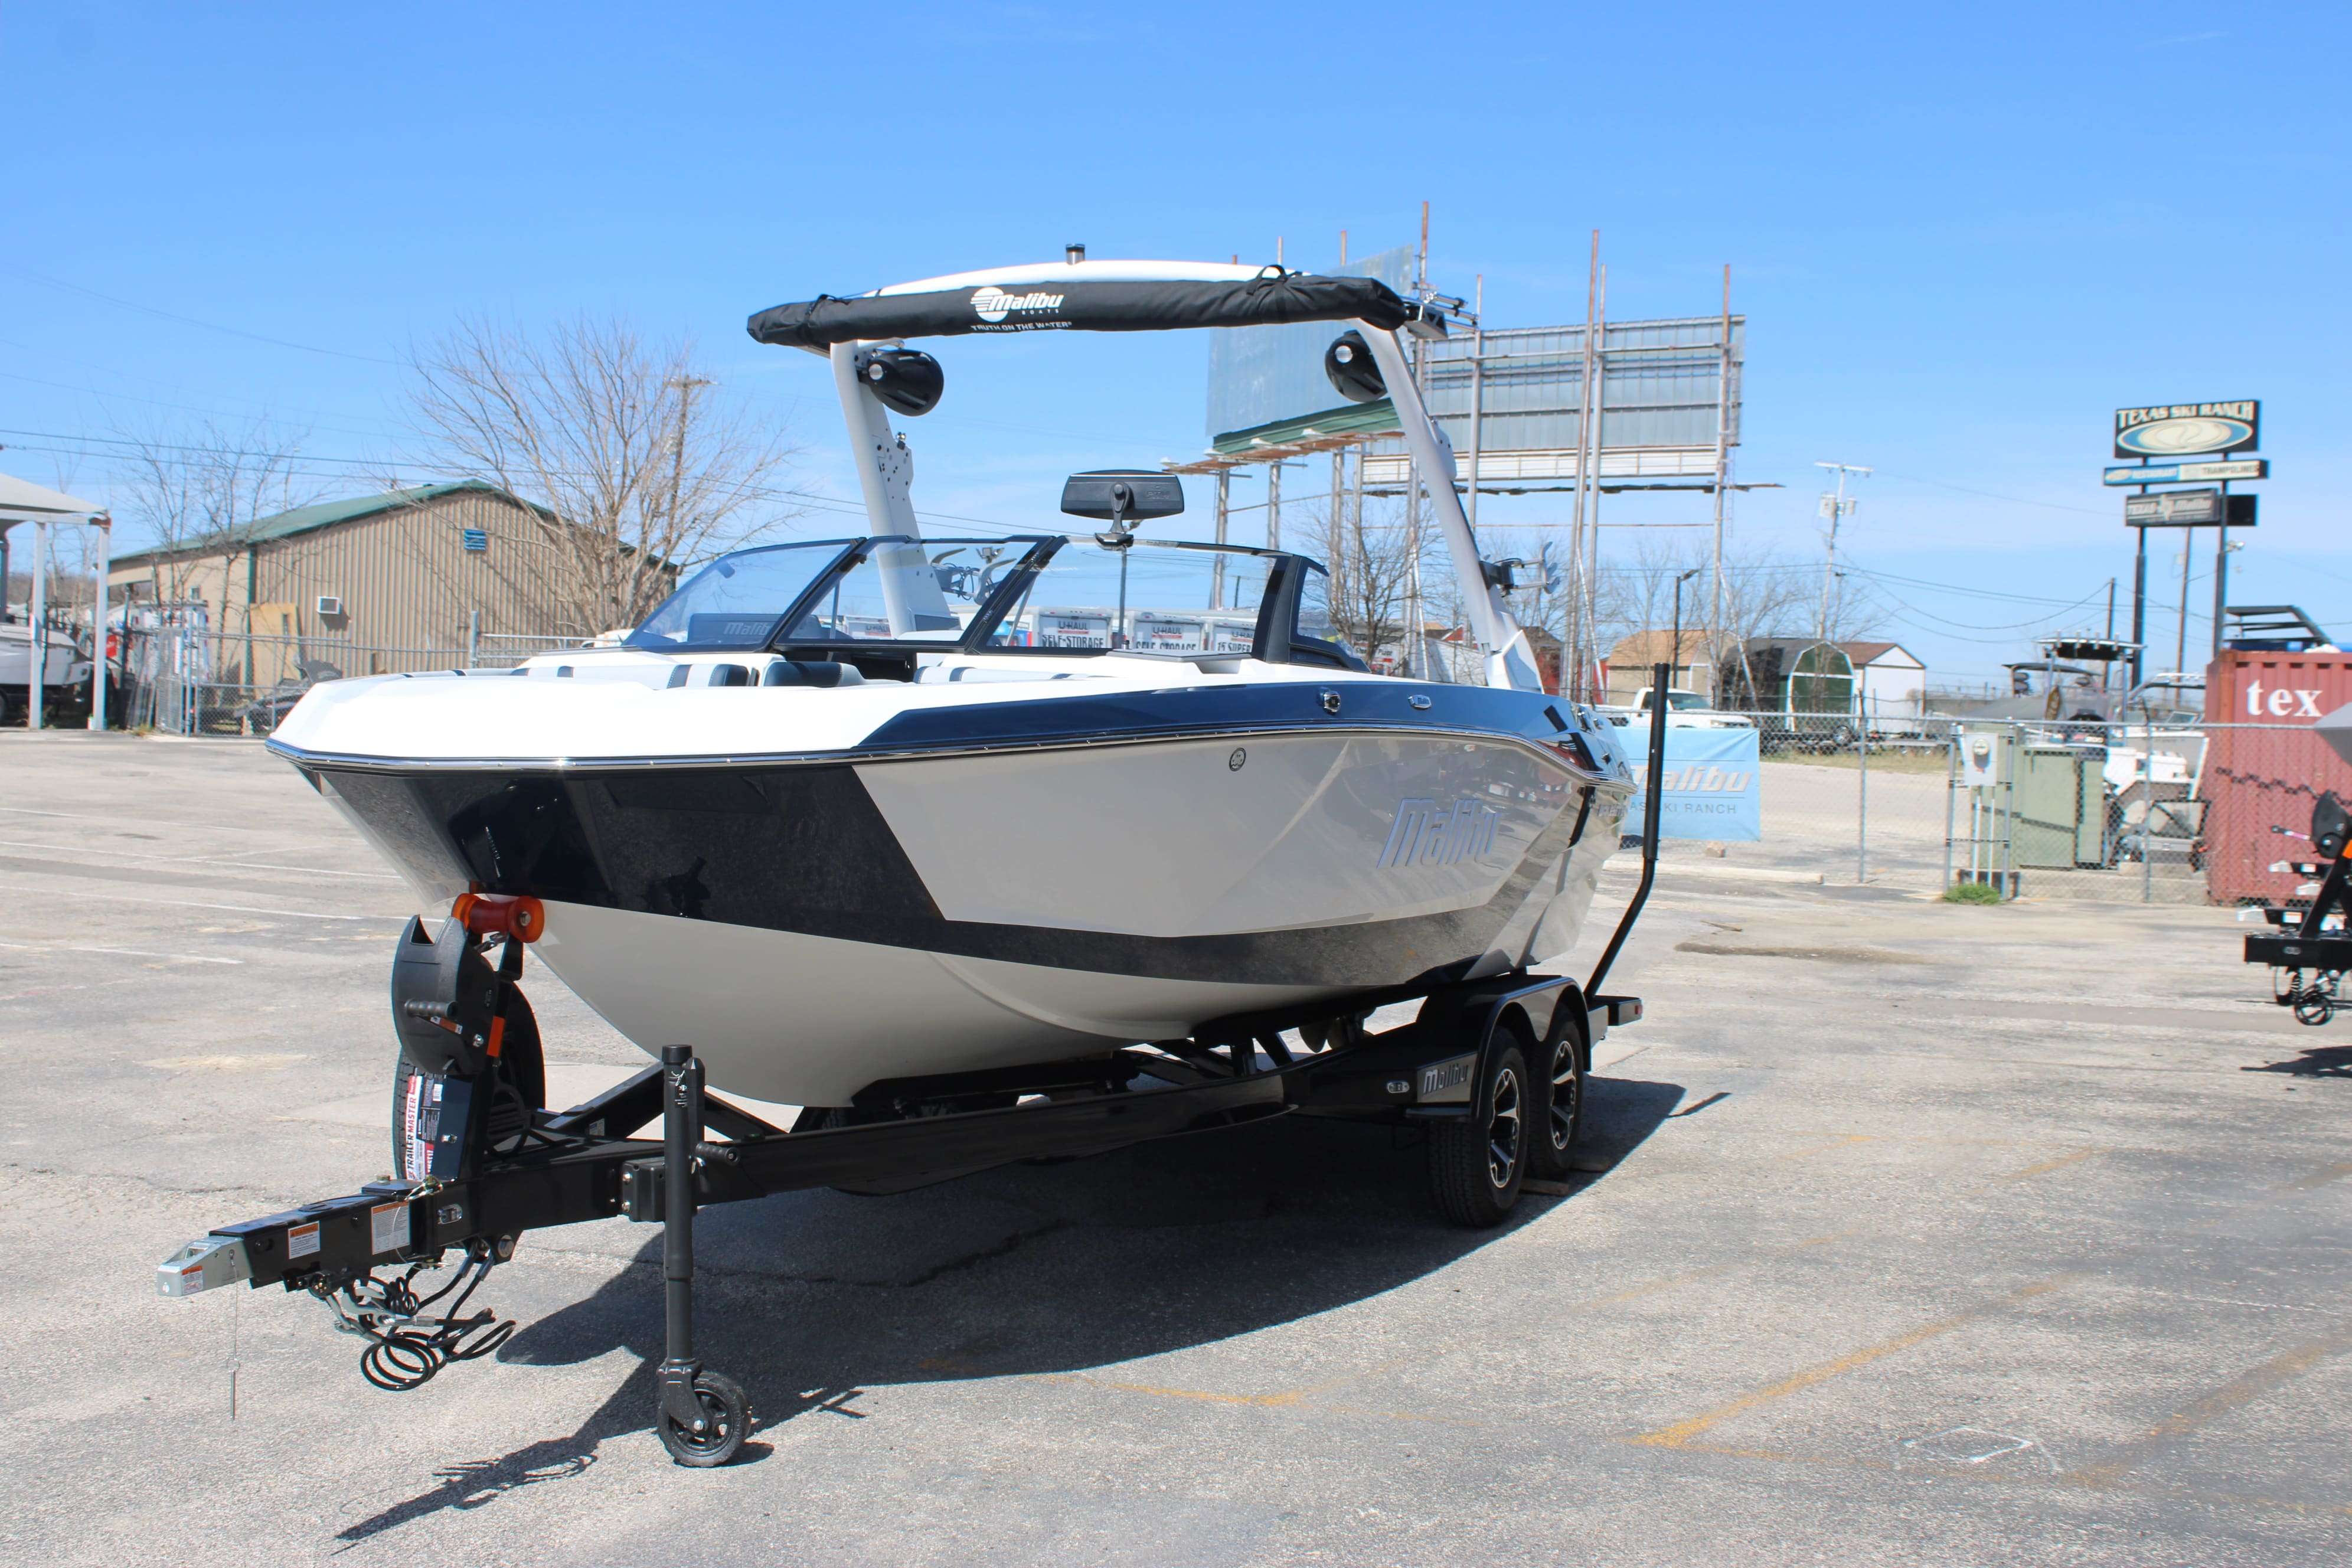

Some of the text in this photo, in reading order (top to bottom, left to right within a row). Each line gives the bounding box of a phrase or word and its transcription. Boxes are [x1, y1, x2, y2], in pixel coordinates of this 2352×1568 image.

[989, 293, 1064, 311] Malibu
[2118, 401, 2255, 428] TEXAS SKI RANCH
[723, 622, 770, 635] Malib
[2246, 680, 2323, 717] tex
[1684, 803, 1737, 814] RANCH
[1423, 1063, 1469, 1094] Malibu
[407, 1097, 417, 1132] MASTER
[406, 1134, 414, 1170] TRAILER
